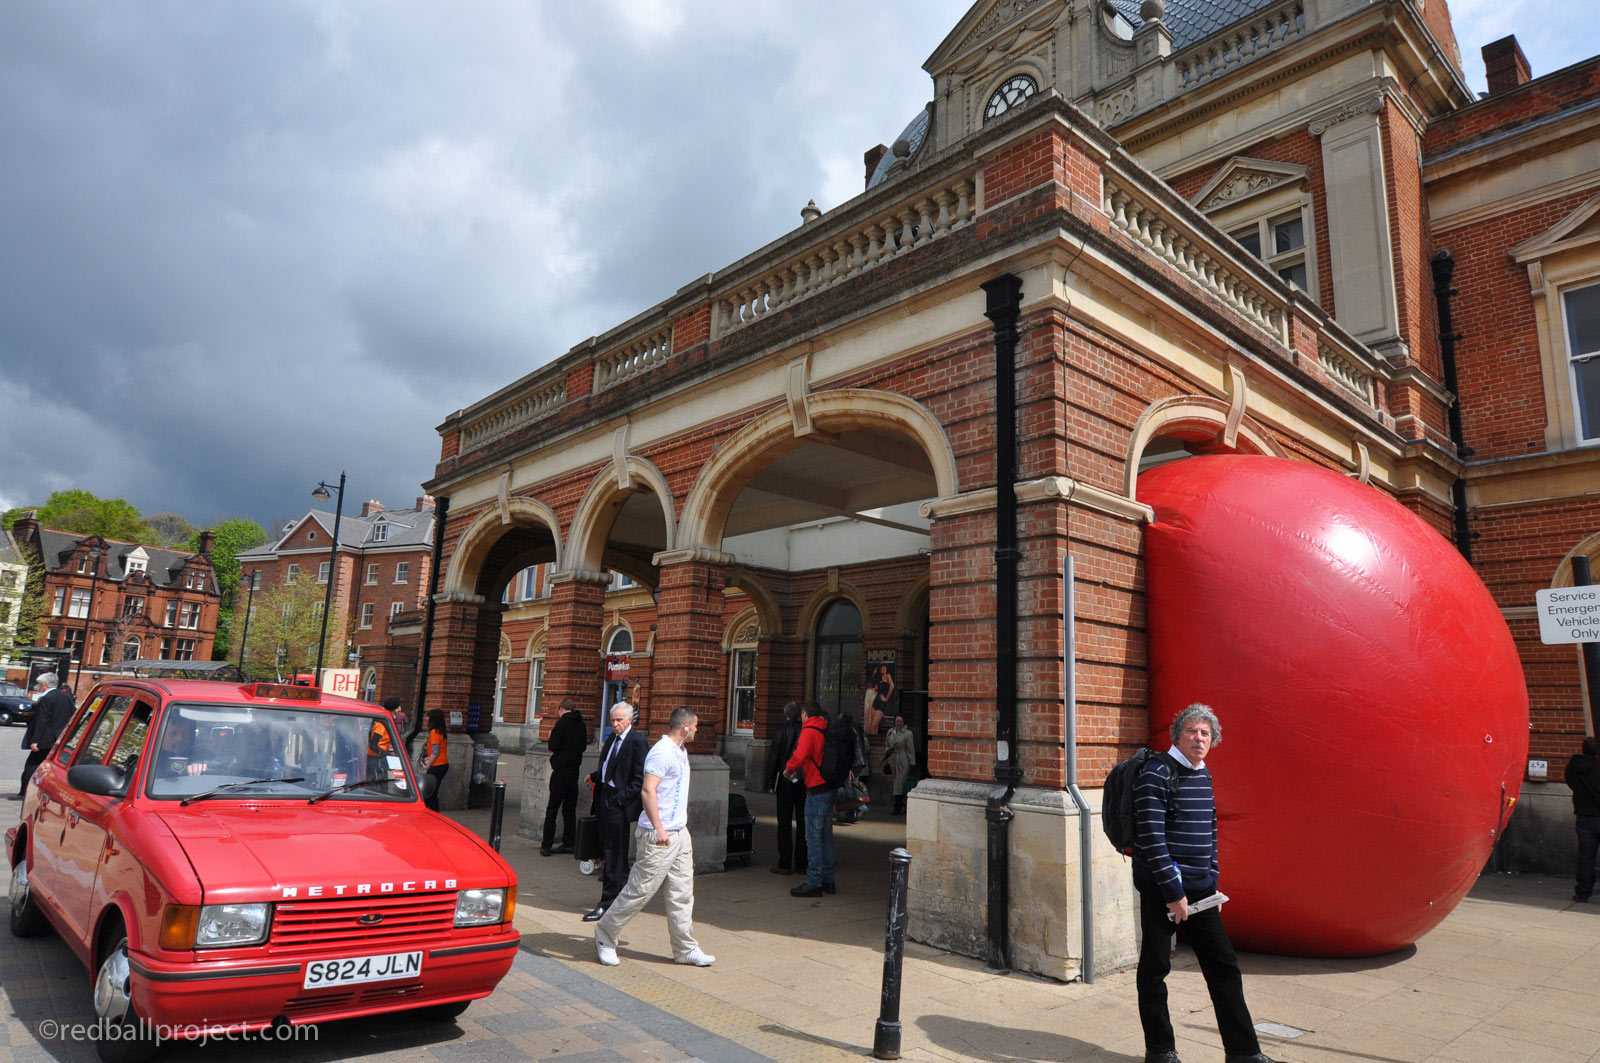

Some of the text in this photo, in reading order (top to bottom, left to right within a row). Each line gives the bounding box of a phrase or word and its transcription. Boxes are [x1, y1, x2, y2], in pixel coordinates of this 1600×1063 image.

[1550, 592, 1596, 603] Service
[1571, 628, 1599, 639] Only
[282, 879, 457, 898] METROCAB
[308, 952, 421, 983] S824 JLN
